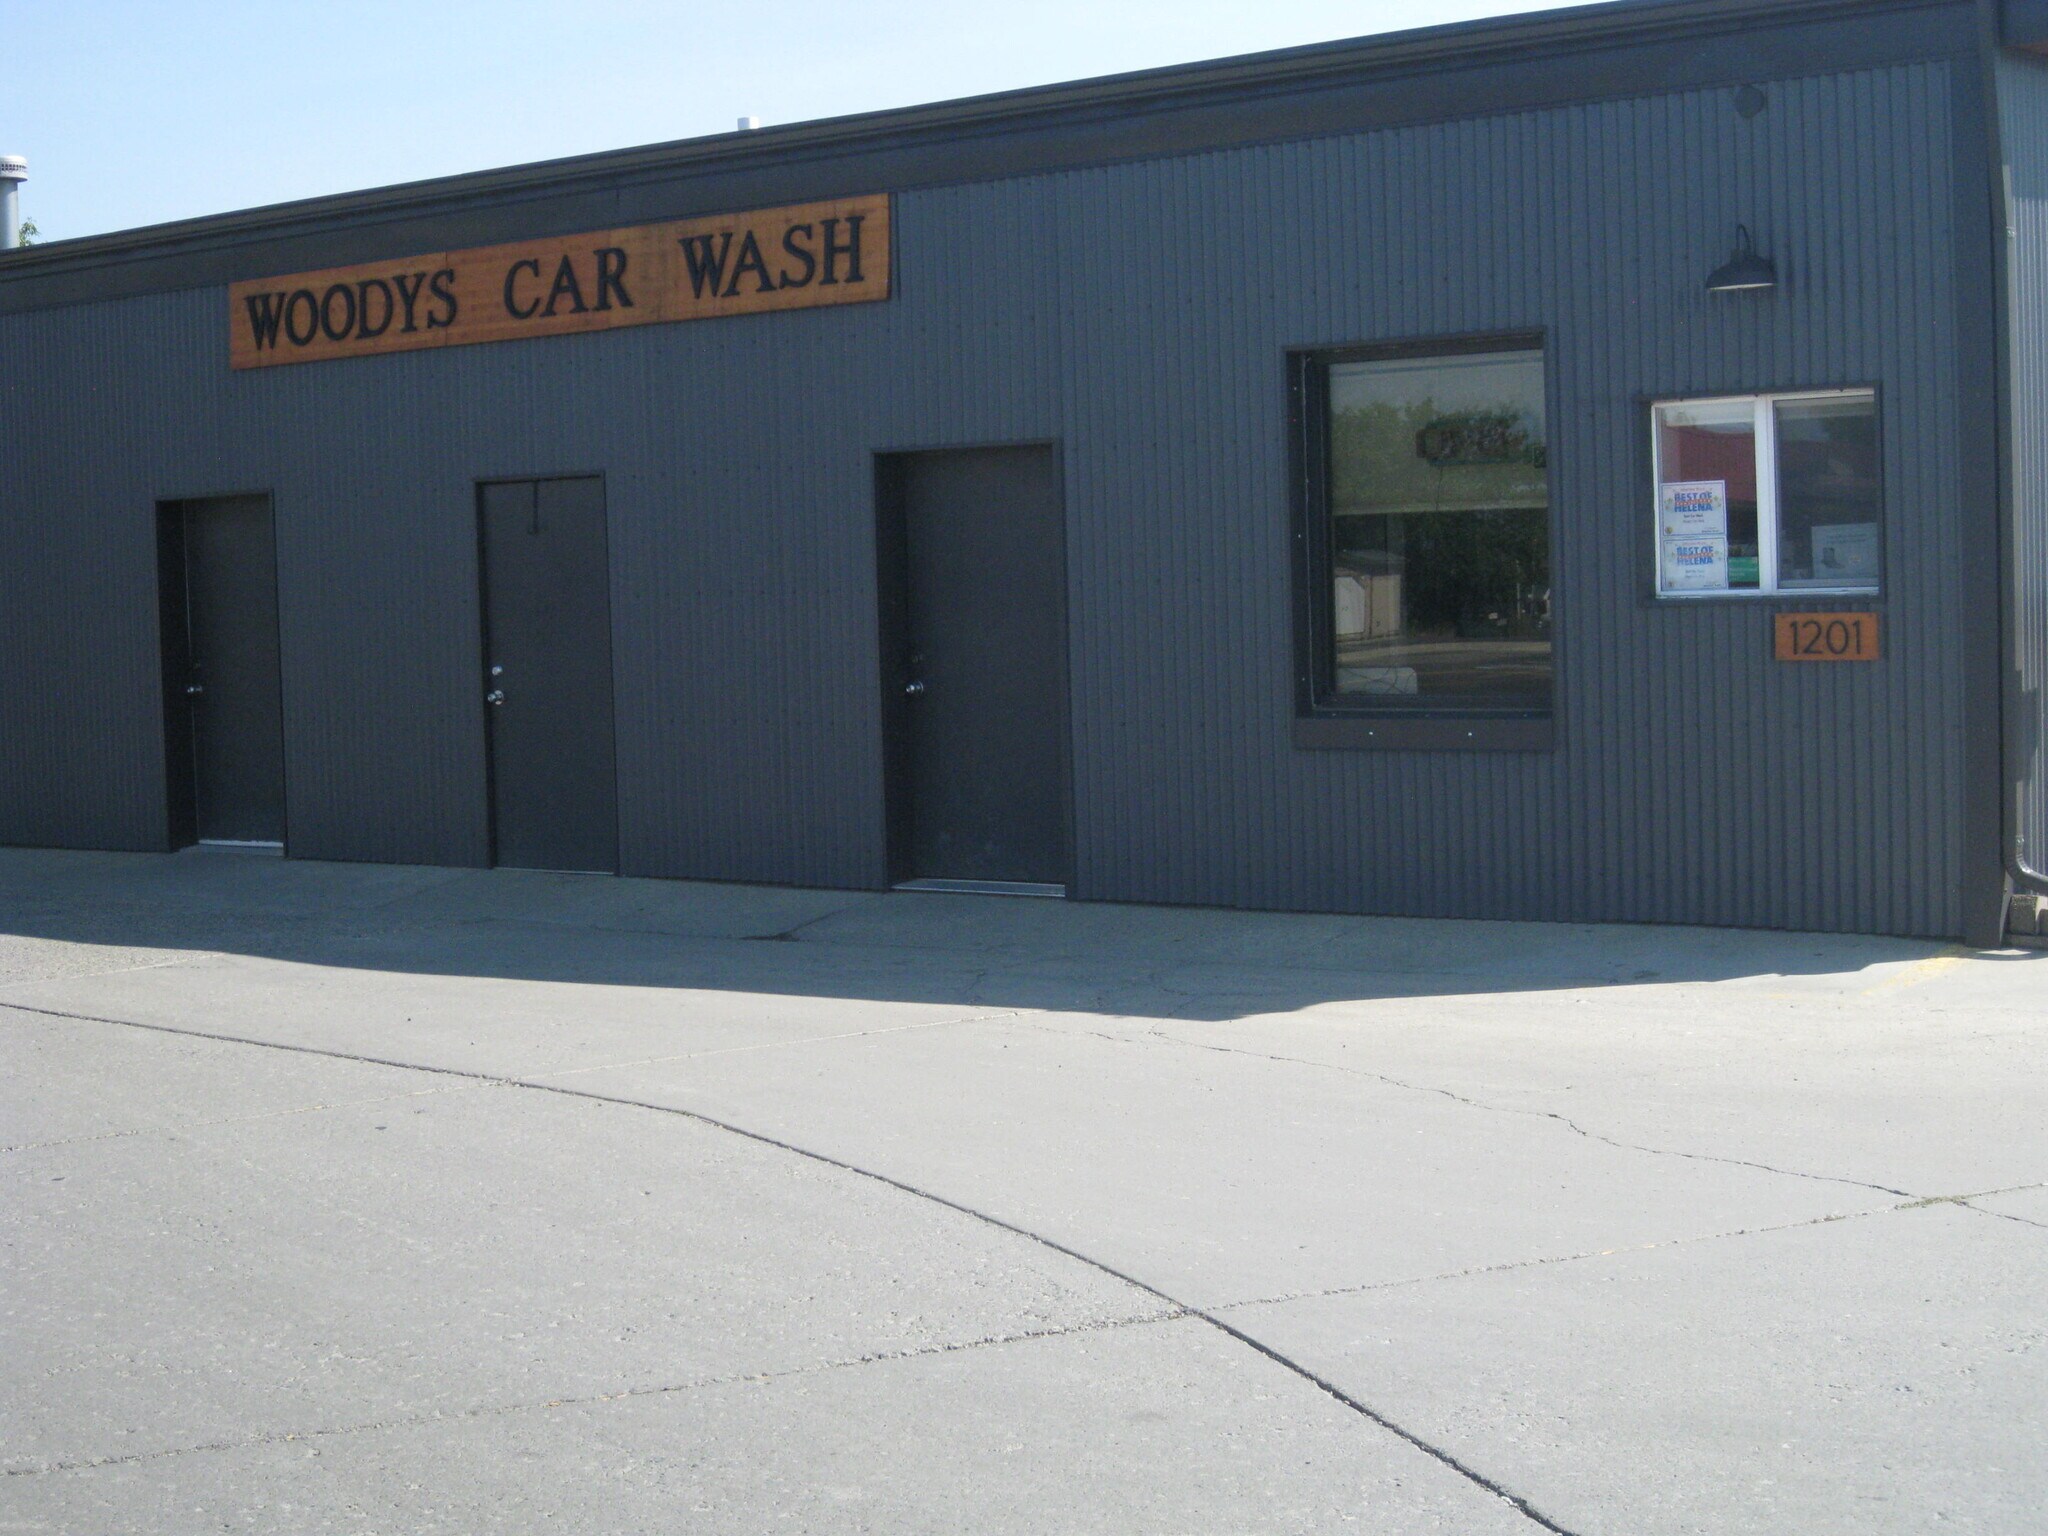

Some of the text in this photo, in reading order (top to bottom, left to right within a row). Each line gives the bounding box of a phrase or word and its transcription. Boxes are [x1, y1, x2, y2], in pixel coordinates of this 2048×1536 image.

[245, 215, 866, 351] WOODYS CAR WASH
[1674, 492, 1713, 501] BEST OF
[1674, 504, 1713, 512] HELENA
[1676, 546, 1699, 555] BEST
[1677, 557, 1714, 566] HELENA
[1790, 619, 1862, 655] 1201
